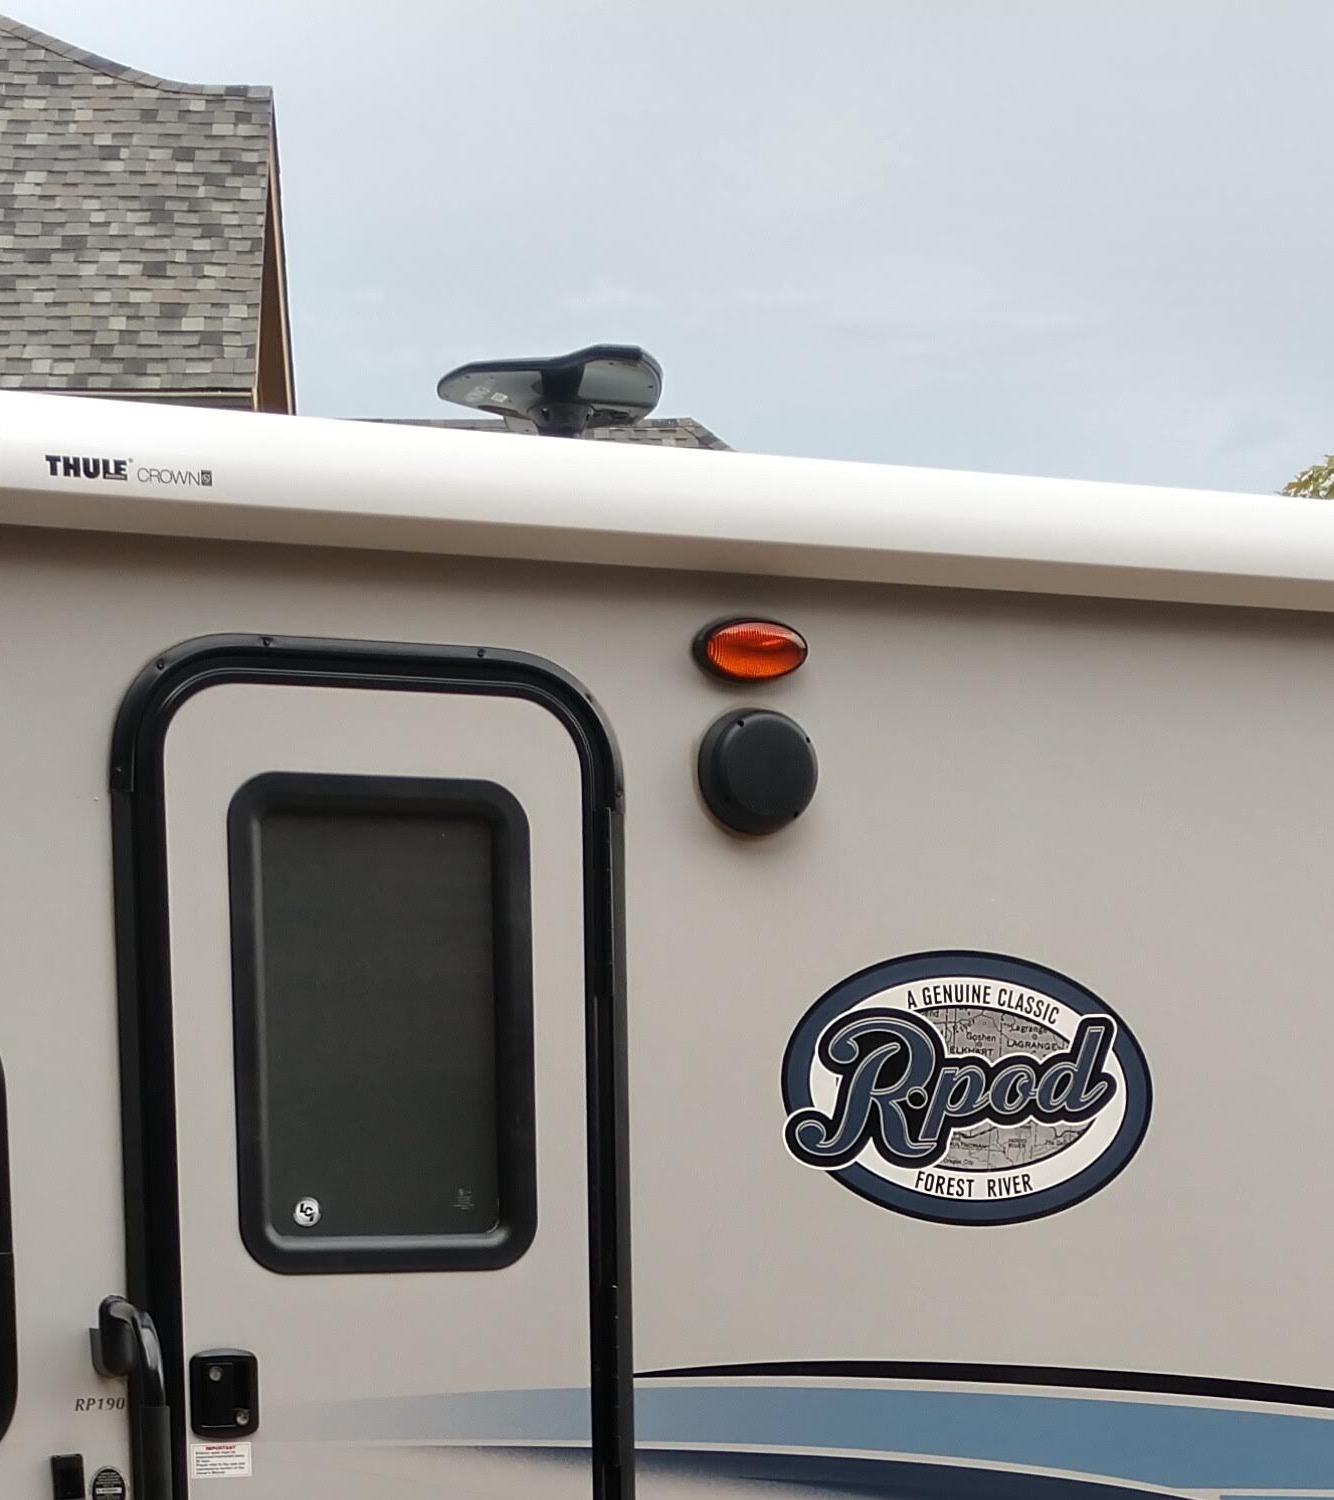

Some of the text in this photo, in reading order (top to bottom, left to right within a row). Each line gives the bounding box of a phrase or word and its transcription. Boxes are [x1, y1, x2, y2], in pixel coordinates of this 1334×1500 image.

[45, 455, 128, 481] THULE
[907, 984, 1061, 1026] A GENUINE CLASSIC
[966, 1031, 996, 1042] Goshen
[949, 1046, 994, 1056] ELKHART
[1007, 1041, 1058, 1051] LAGRANGE
[914, 1170, 1034, 1199] FOREST RIVER
[75, 1397, 126, 1412] RP190
